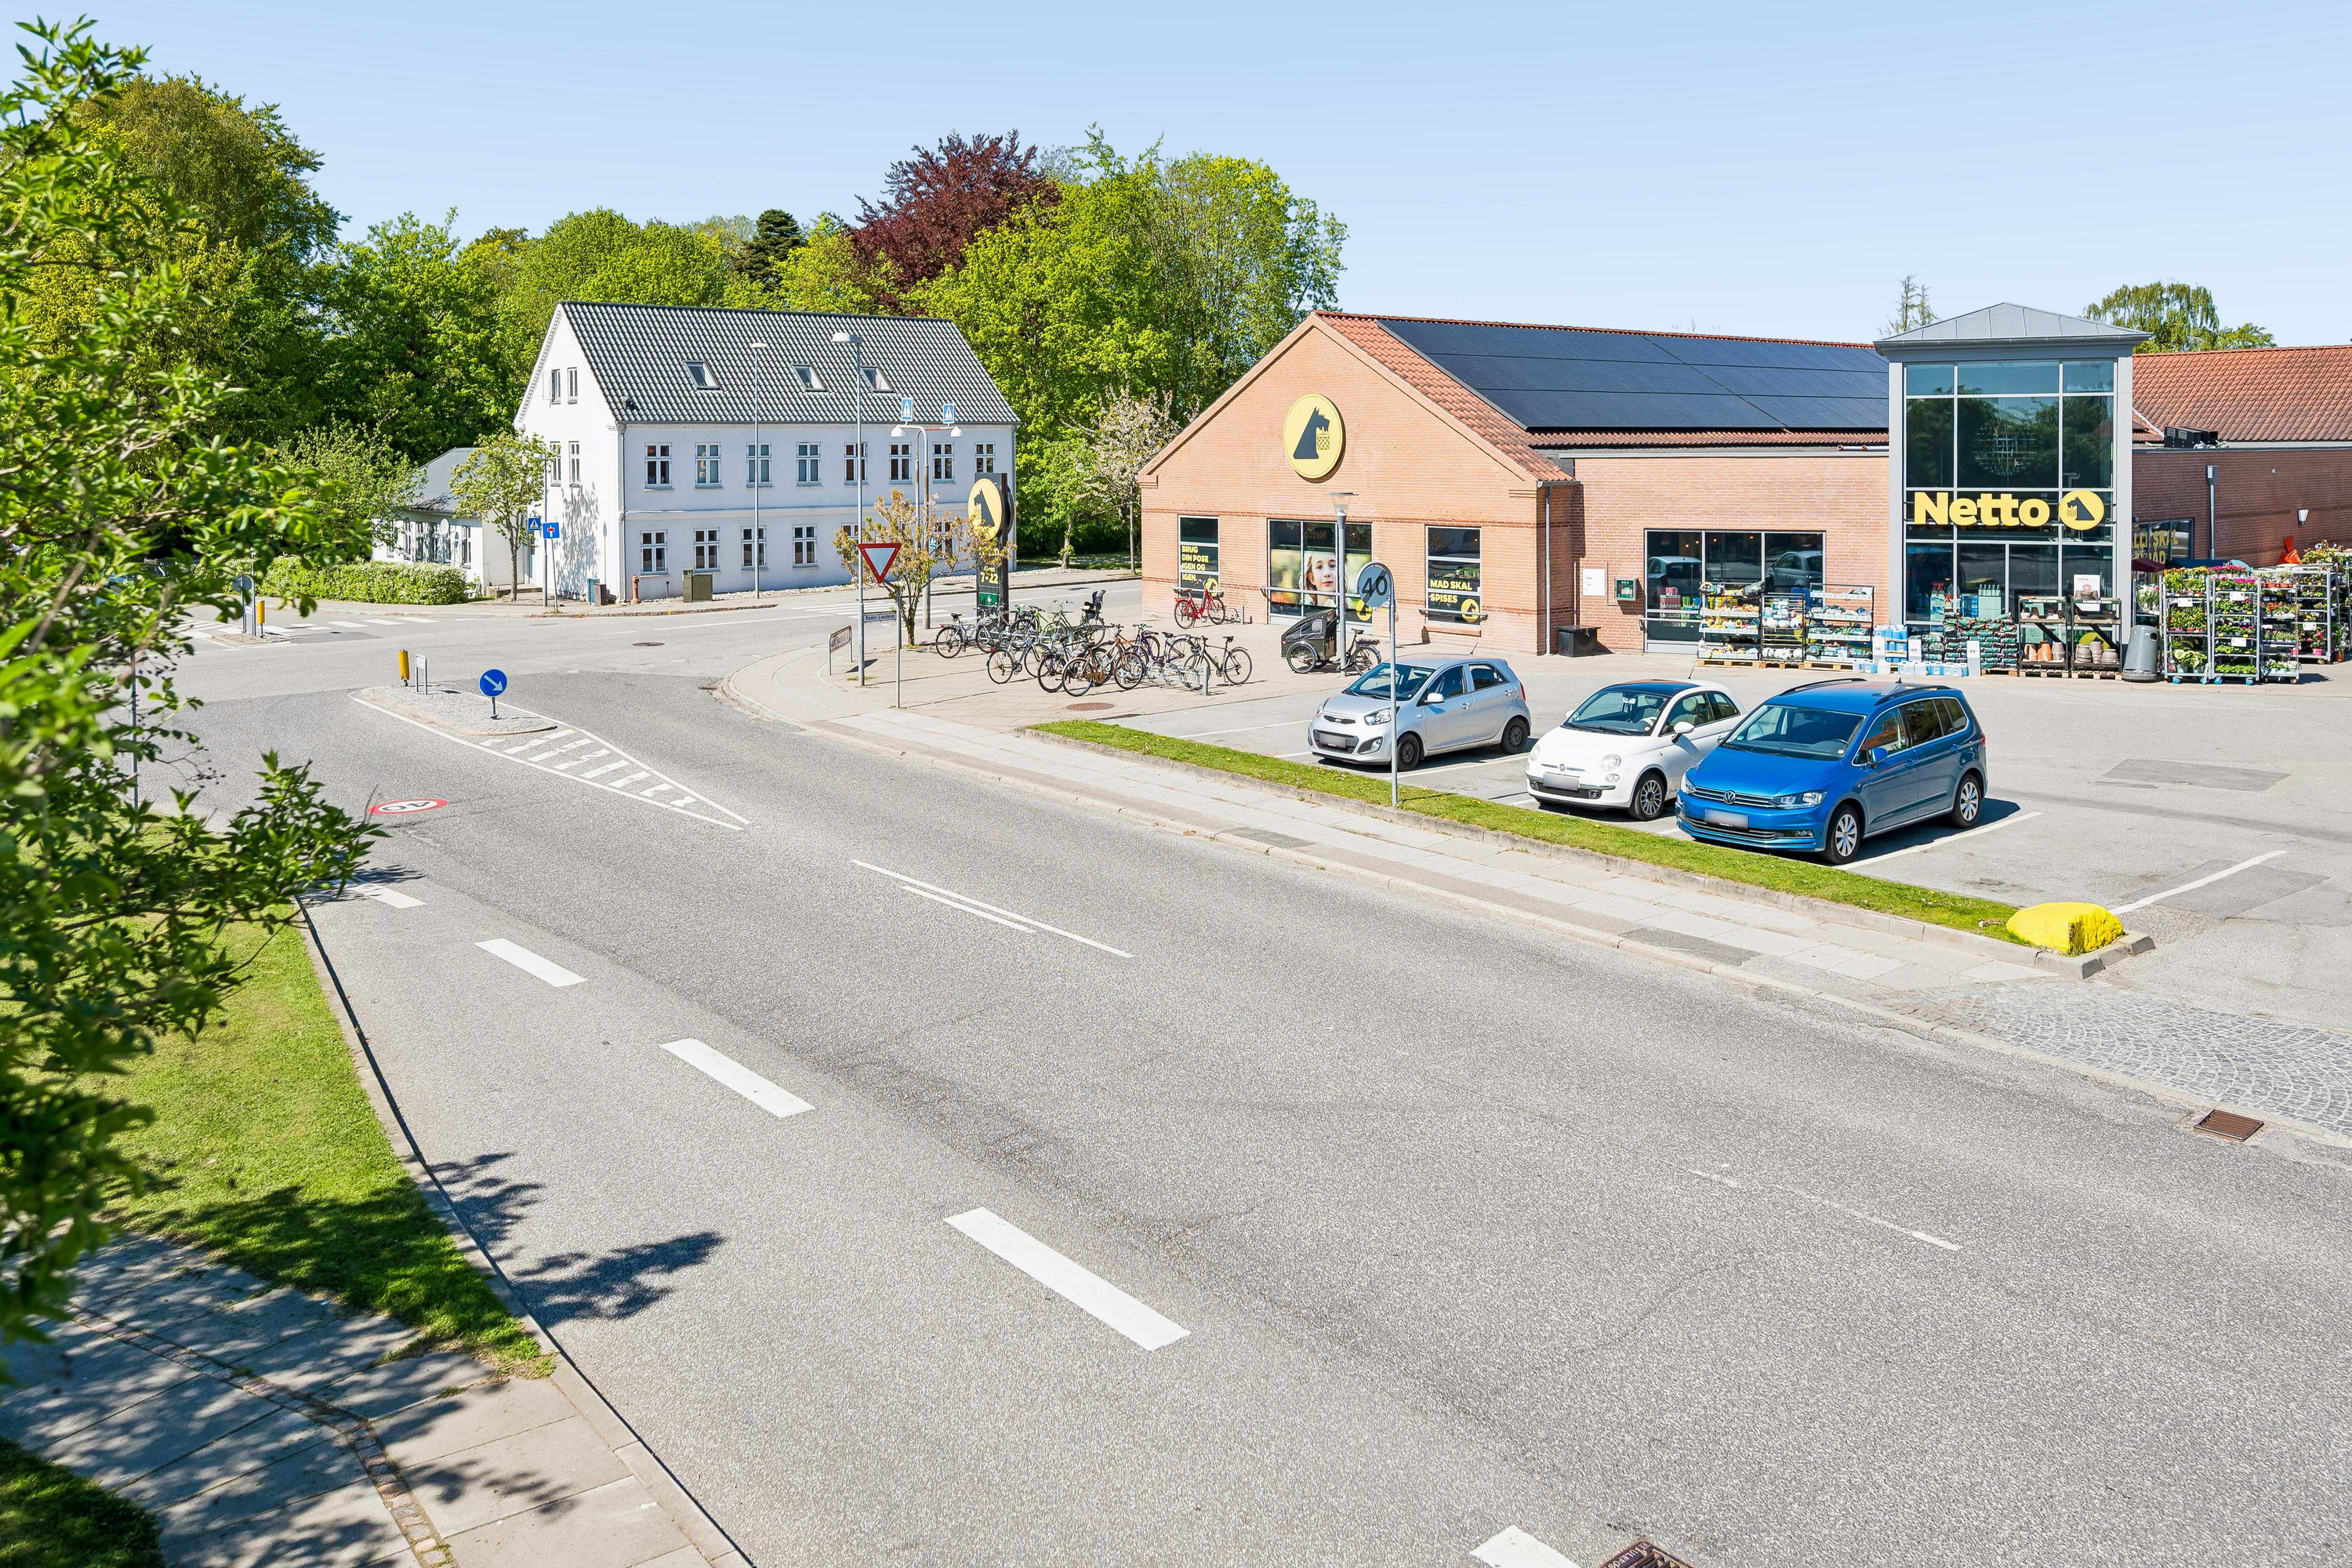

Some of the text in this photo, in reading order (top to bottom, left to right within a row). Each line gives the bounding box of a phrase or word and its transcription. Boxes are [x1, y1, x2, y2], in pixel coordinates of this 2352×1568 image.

[1914, 492, 2050, 527] Netto
[2132, 532, 2151, 549] LL
[1181, 545, 1199, 554] BRUG
[1192, 554, 1209, 563] POSE
[1181, 572, 1196, 581] IGEN
[1362, 575, 1388, 596] 40
[1430, 579, 1472, 590] MAD SKAL
[1430, 593, 1457, 604] SPISES
